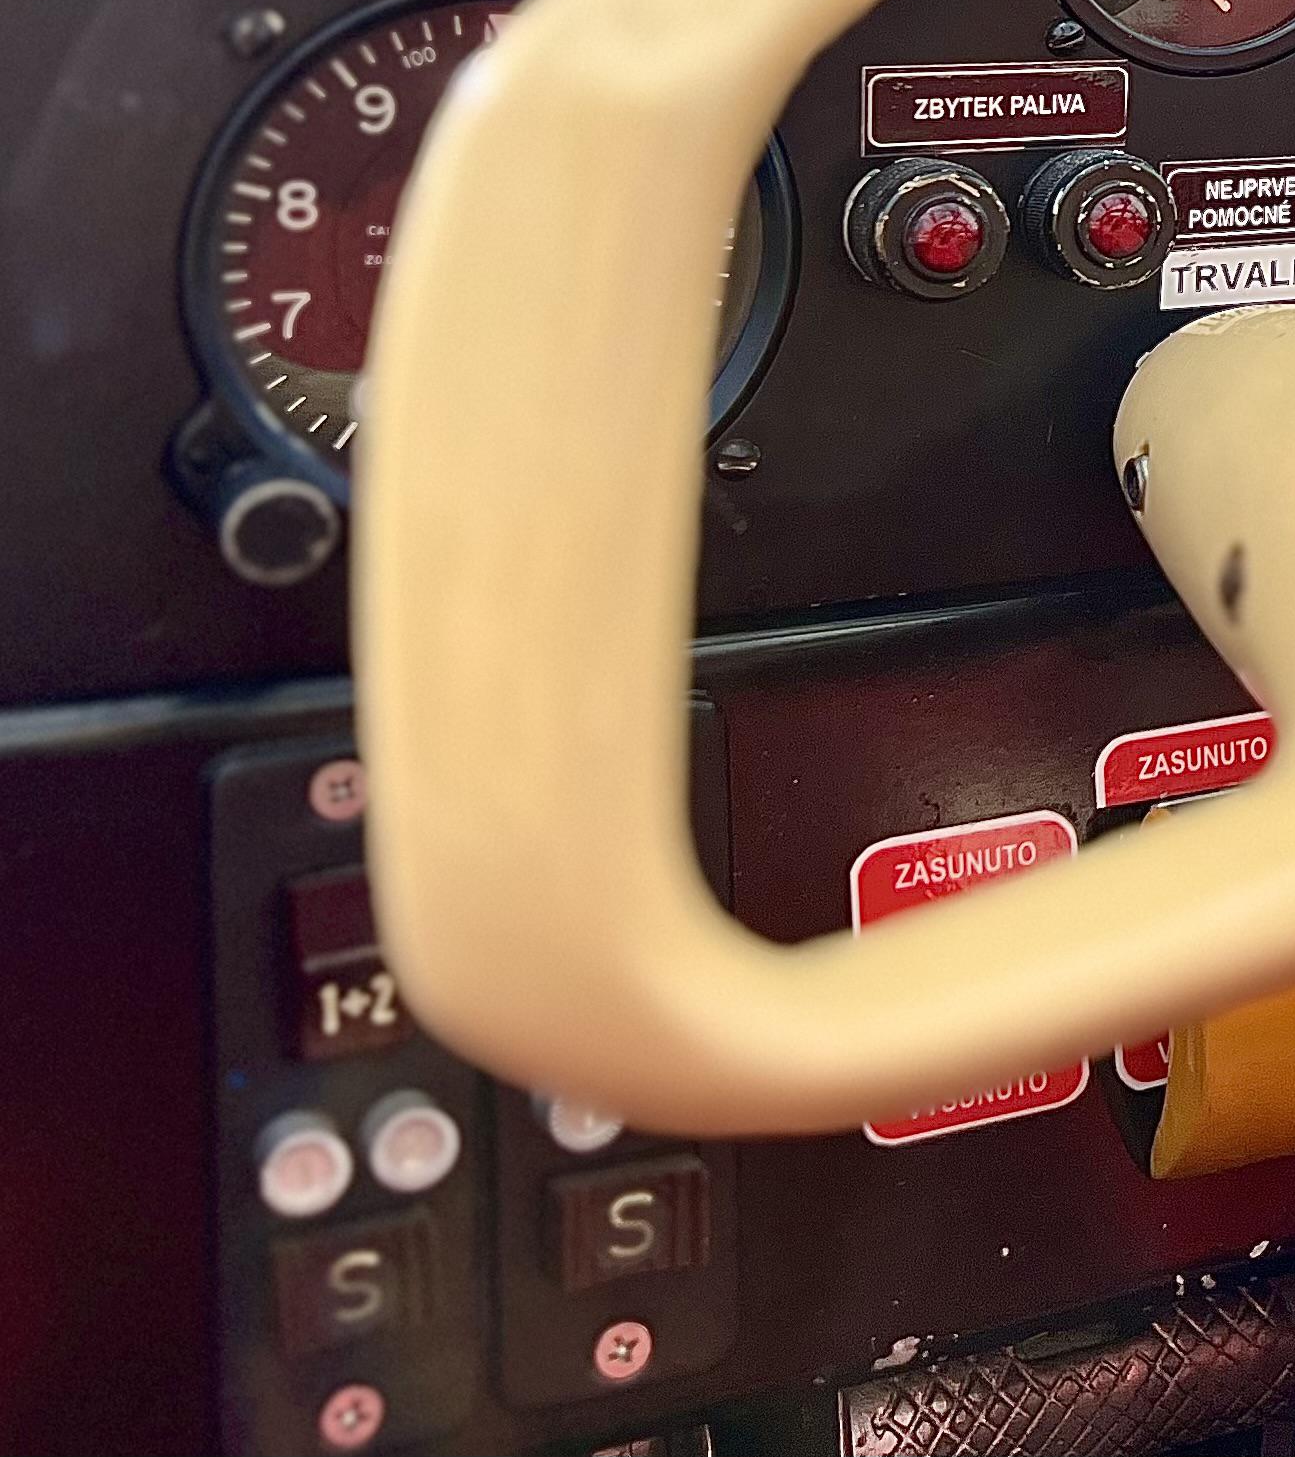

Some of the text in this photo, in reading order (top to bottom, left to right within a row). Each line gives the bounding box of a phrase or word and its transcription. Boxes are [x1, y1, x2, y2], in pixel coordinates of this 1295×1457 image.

[402, 46, 437, 69] 100
[354, 85, 395, 135] 9
[913, 93, 1086, 121] ZBYTEK PALIVA
[276, 179, 318, 230] 8
[1188, 200, 1291, 229] POMOCNÉ
[271, 291, 312, 340] 7
[1137, 736, 1269, 781] ZASUNUTO
[894, 840, 1037, 890] ZASUNUTO
[608, 1192, 655, 1258] S
[329, 1250, 382, 1323] S
